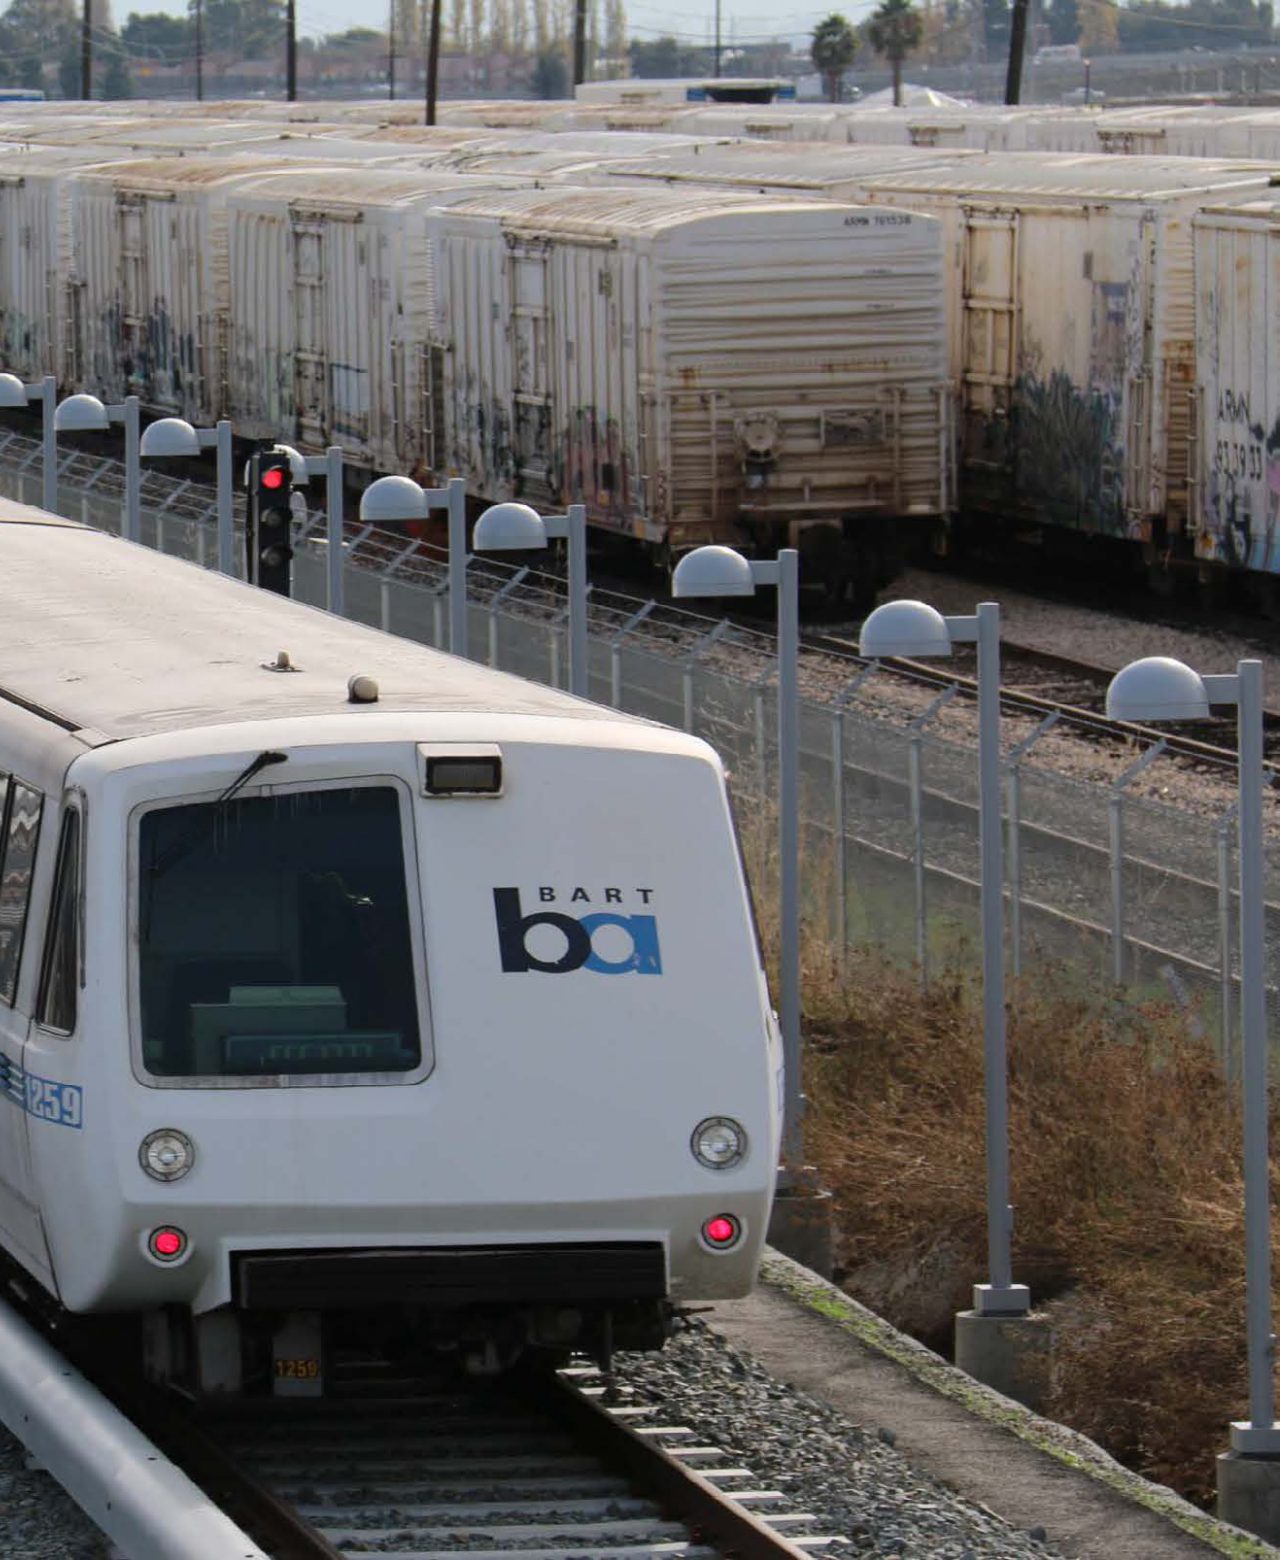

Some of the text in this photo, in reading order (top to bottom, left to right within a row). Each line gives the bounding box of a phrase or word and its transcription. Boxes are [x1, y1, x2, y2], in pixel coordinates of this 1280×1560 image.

[1218, 388, 1251, 422] ARMN
[539, 887, 654, 904] BART
[24, 1074, 82, 1127] 1259
